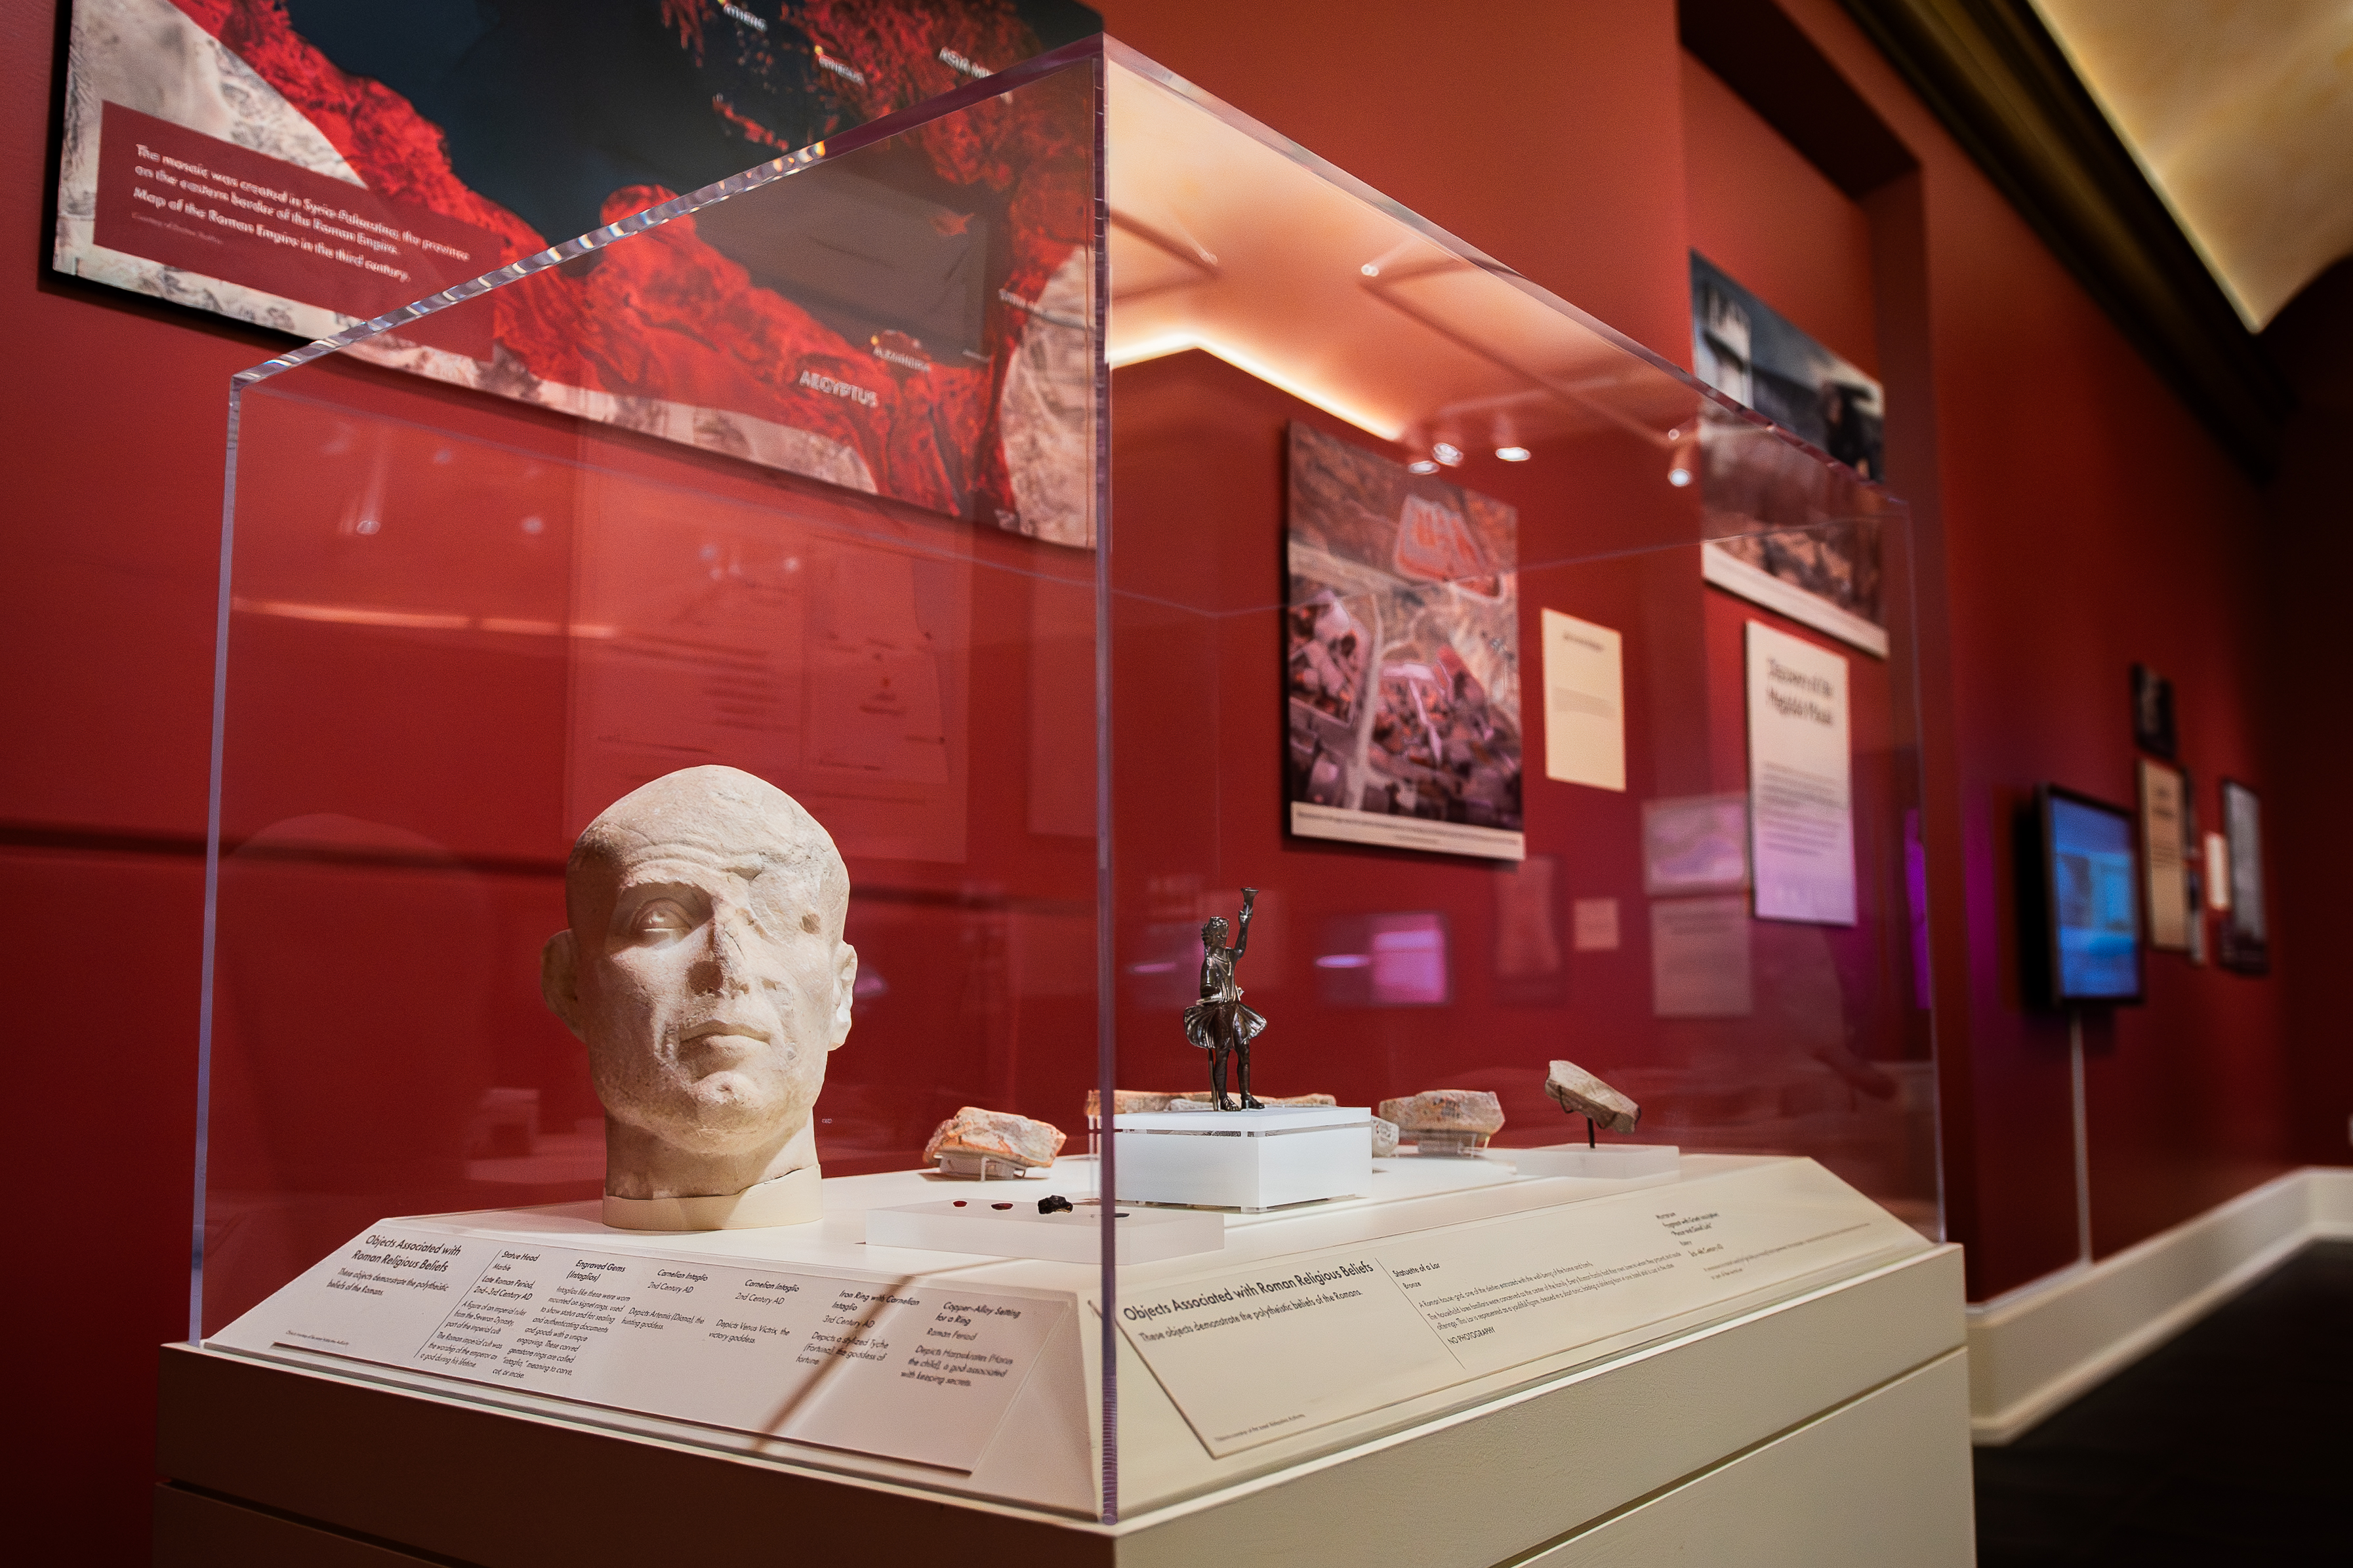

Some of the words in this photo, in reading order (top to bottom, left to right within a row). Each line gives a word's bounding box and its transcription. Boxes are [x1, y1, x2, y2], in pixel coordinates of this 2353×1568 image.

[208, 209, 255, 233] Roman
[366, 1235, 396, 1248] Objects
[396, 1240, 444, 1253] Associated
[441, 1245, 461, 1256] with
[352, 1250, 381, 1262] Roman
[381, 1255, 420, 1268] Religious
[419, 1260, 448, 1272] Beliefs
[576, 1260, 608, 1270] Engraved
[607, 1264, 625, 1272] Gems
[566, 1270, 601, 1282] (Intaglios)
[1393, 1268, 1419, 1277] Statuette
[338, 1268, 354, 1277] These
[353, 1270, 373, 1280] objects
[373, 1274, 407, 1285] demonstrate
[406, 1278, 416, 1287] the
[414, 1281, 449, 1291] polytheistic
[494, 1277, 514, 1285] Roman
[327, 1279, 346, 1289] beliefs
[361, 1285, 383, 1295] Romans.
[557, 1286, 578, 1295] Intaglios
[661, 1283, 682, 1293] Century
[1124, 1304, 1171, 1320] Objects
[1172, 1288, 1233, 1311] Associated
[1233, 1283, 1259, 1298] with
[1256, 1280, 1296, 1293] Roman
[1294, 1271, 1341, 1285] Religious
[1340, 1261, 1373, 1276] Beliefs
[499, 1289, 522, 1300] Century
[749, 1295, 772, 1305] Century
[854, 1292, 869, 1302] Ring
[595, 1315, 615, 1324] sealing
[1166, 1325, 1193, 1337] objects
[1194, 1316, 1240, 1331] demonstrate
[1239, 1312, 1253, 1320] the
[1253, 1304, 1293, 1320] polytheistic
[1290, 1297, 1315, 1309] beliefs
[1316, 1295, 1324, 1304] of
[1322, 1294, 1335, 1302] the
[544, 1318, 579, 1330] authenticating
[580, 1323, 608, 1333] documents
[1457, 1327, 1495, 1342] PHOTOGRAPHY
[527, 1363, 550, 1373] meaning
